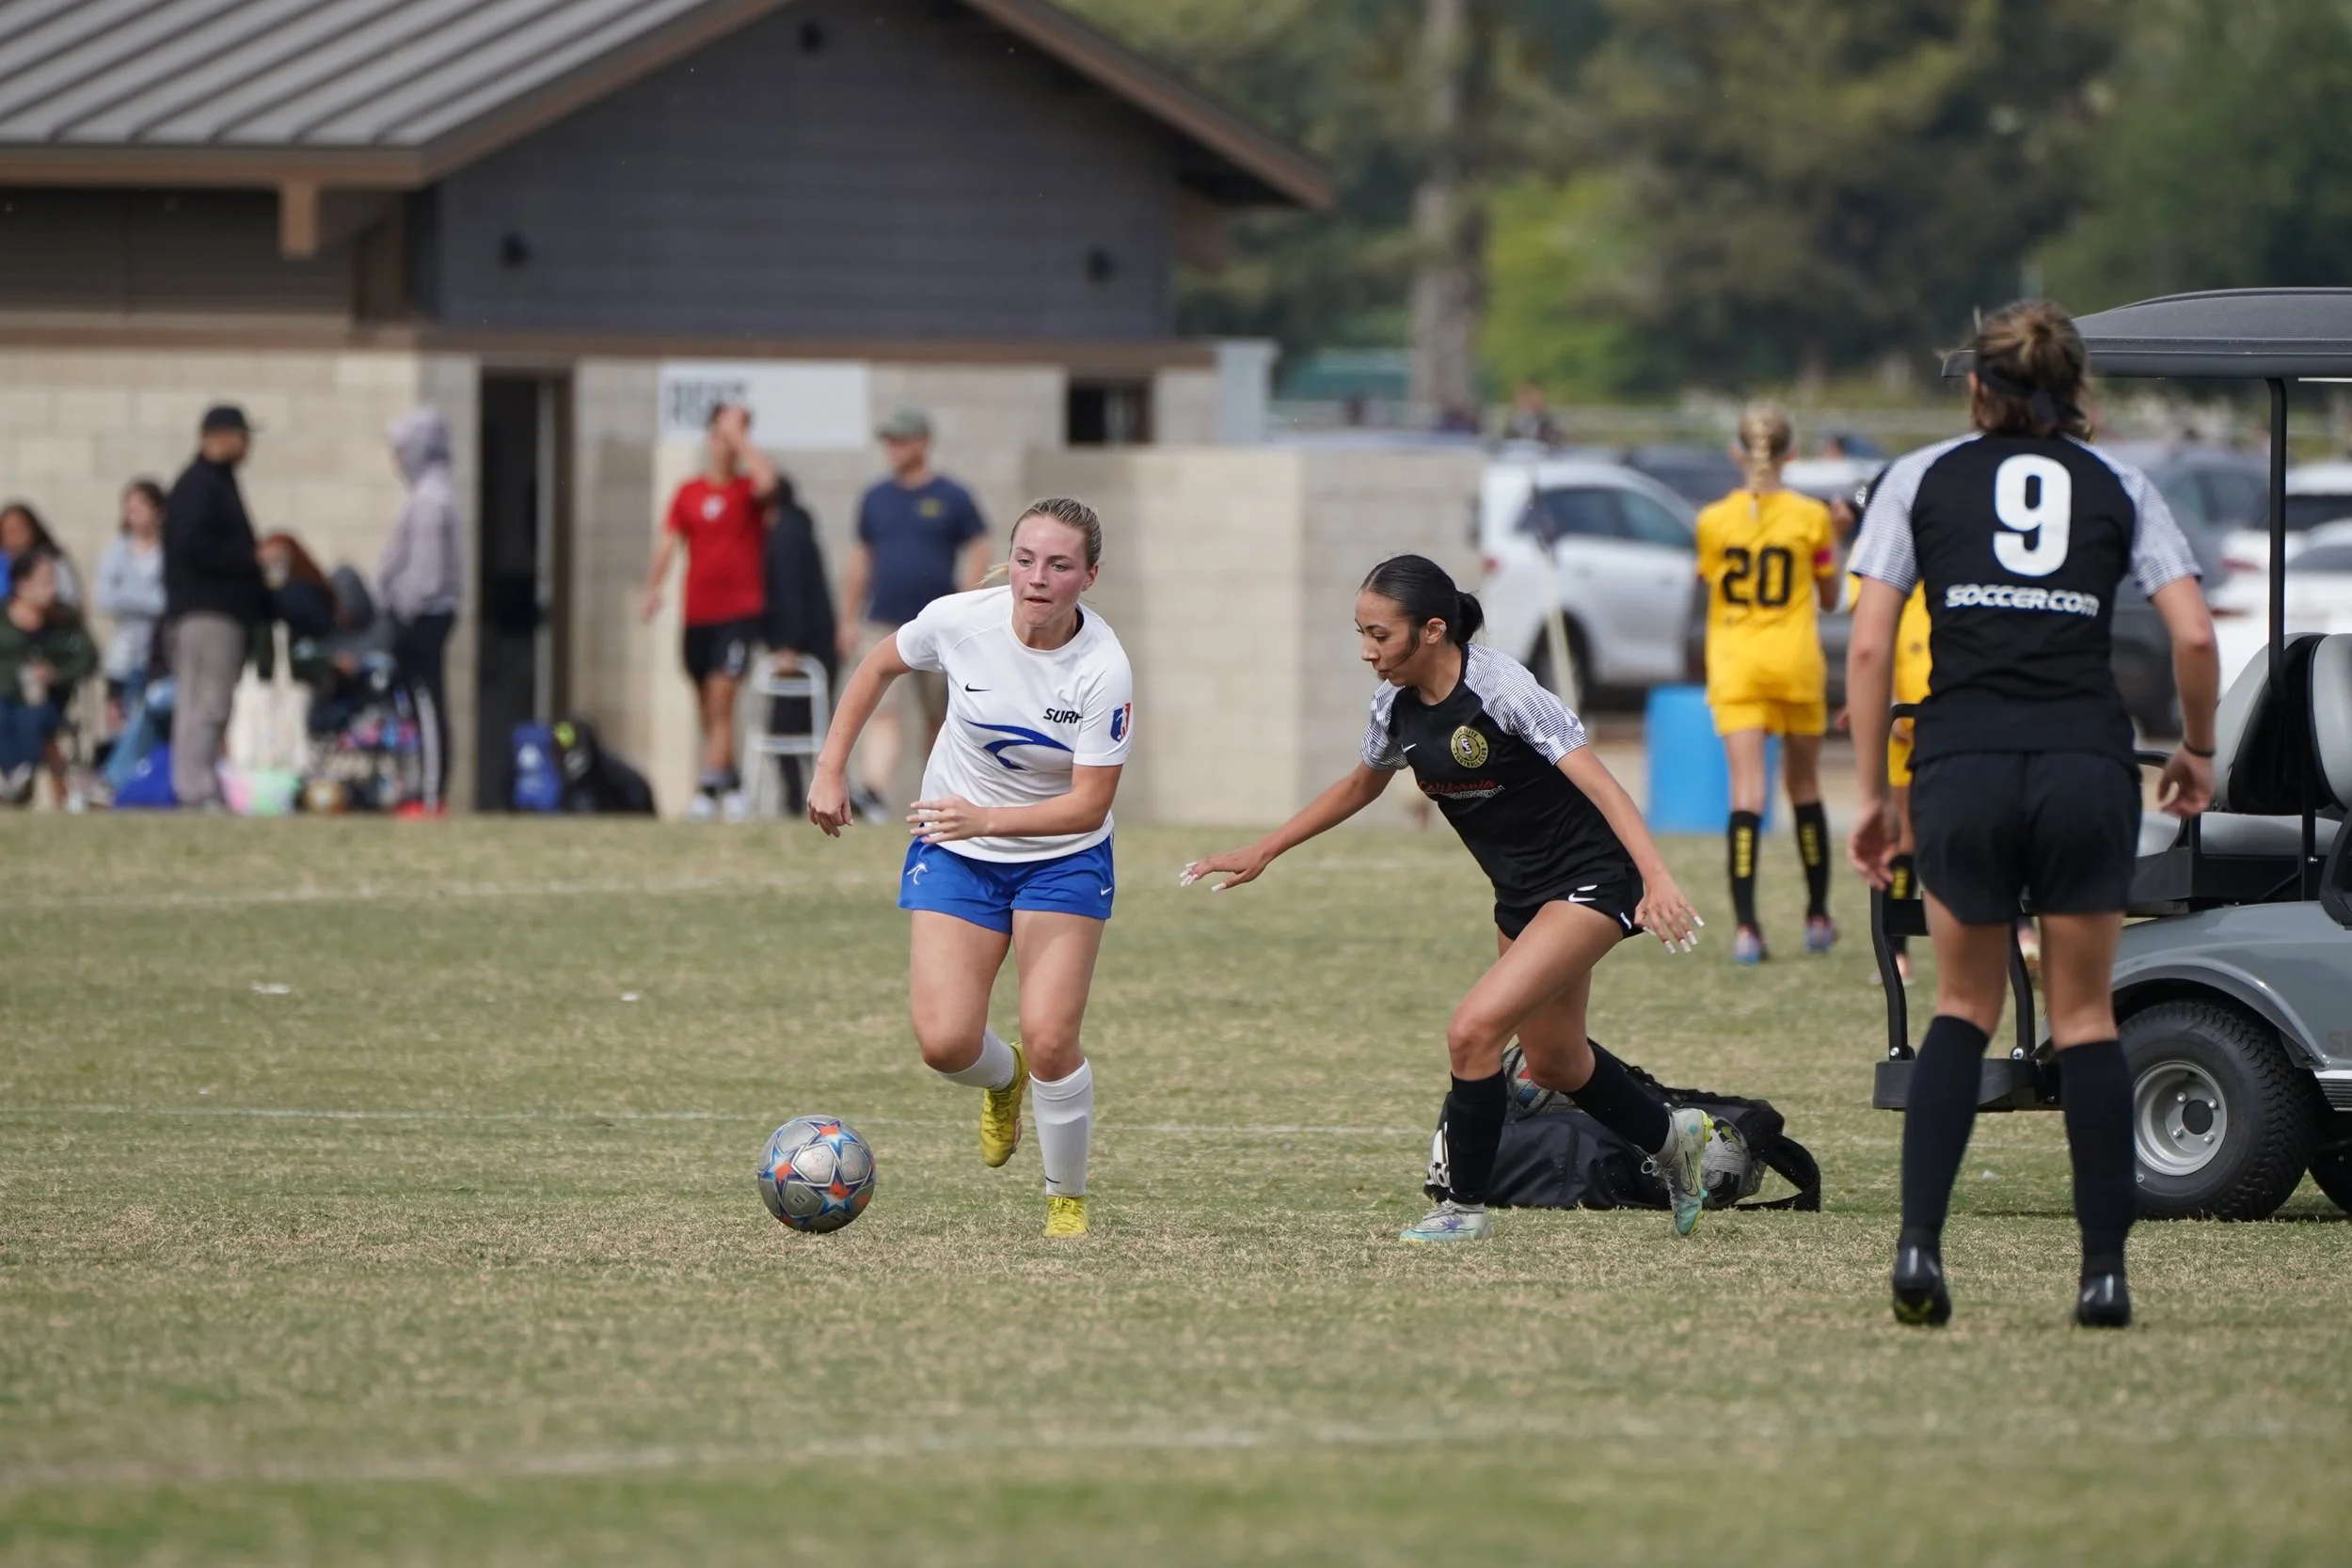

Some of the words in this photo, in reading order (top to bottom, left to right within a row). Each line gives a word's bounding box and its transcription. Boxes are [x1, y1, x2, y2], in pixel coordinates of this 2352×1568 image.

[1993, 453, 2072, 577] 9
[1723, 546, 1792, 606] 20
[1454, 752, 1480, 767] FOOTBALL
